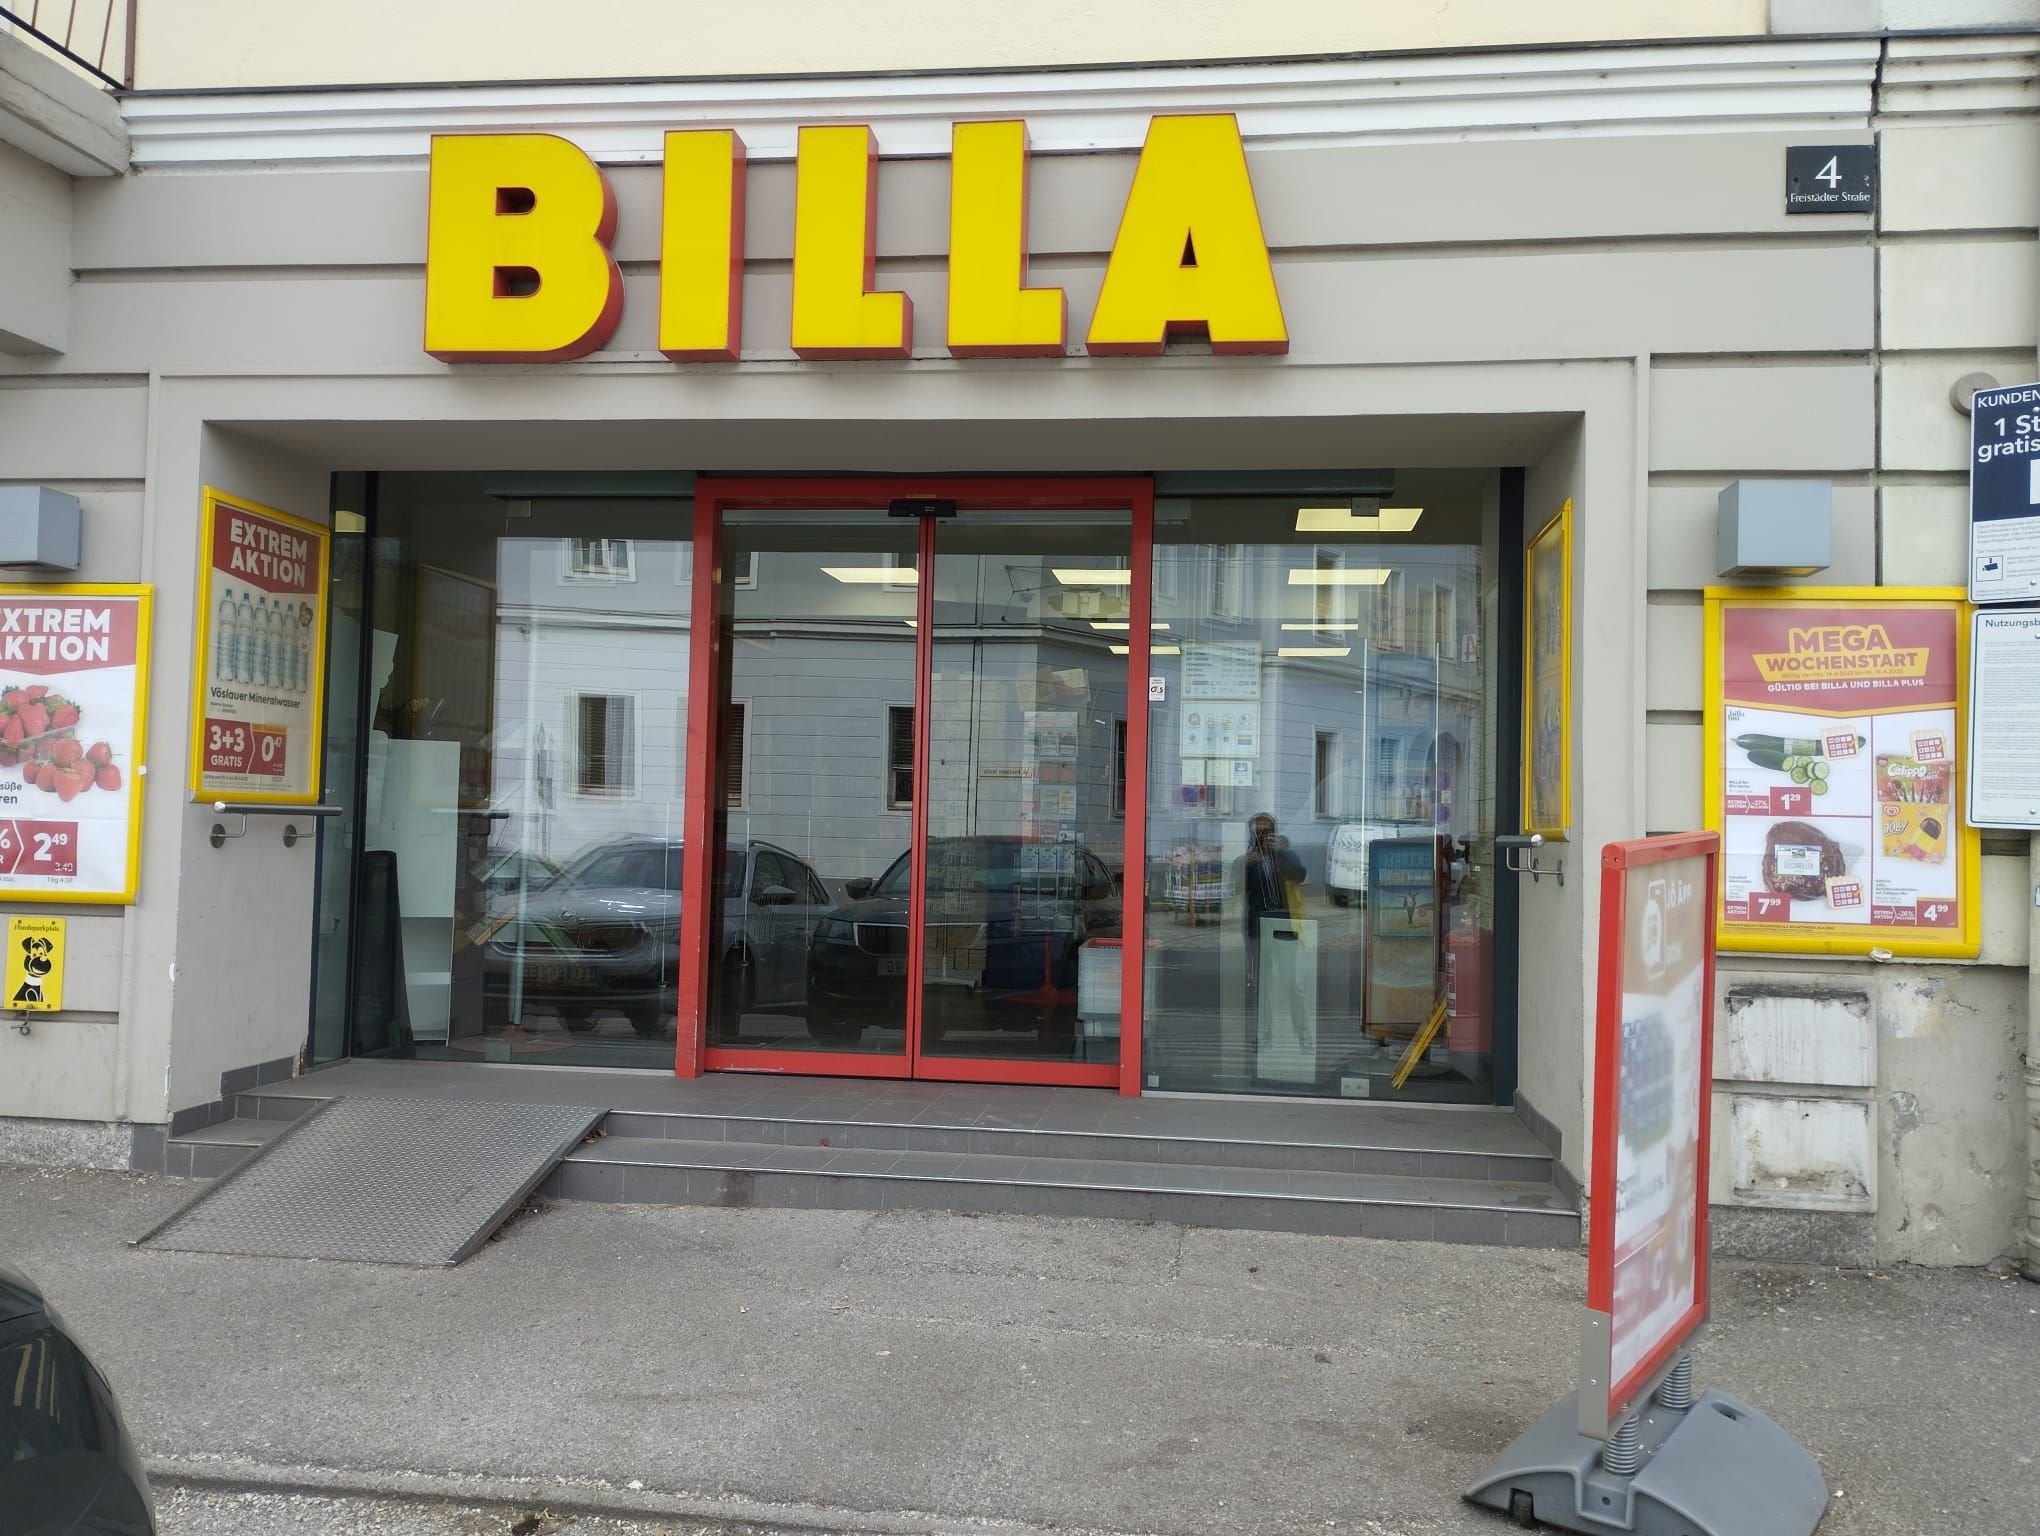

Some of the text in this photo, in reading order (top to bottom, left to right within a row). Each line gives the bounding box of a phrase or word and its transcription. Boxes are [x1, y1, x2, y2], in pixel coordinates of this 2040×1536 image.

[1815, 155, 1842, 189] 4
[1789, 191, 1871, 203] Freistädter Straße
[424, 113, 1289, 363] BILLA
[1994, 417, 2005, 436] 1
[230, 517, 307, 563] EXTREM
[230, 546, 306, 588] AKTION
[0, 607, 111, 634] XTREM
[0, 635, 109, 661] KTION
[1792, 627, 1888, 652] MEGA
[1765, 652, 1918, 672] WOCHENSTART
[211, 686, 300, 709] Vöslauer Mineralwasser
[1767, 678, 1924, 692] GÜLTIG BEI BILLA UND BILLA PLUS
[209, 725, 245, 753] 3+3
[210, 754, 242, 768] GRATIS
[1887, 763, 1927, 778] Calippo
